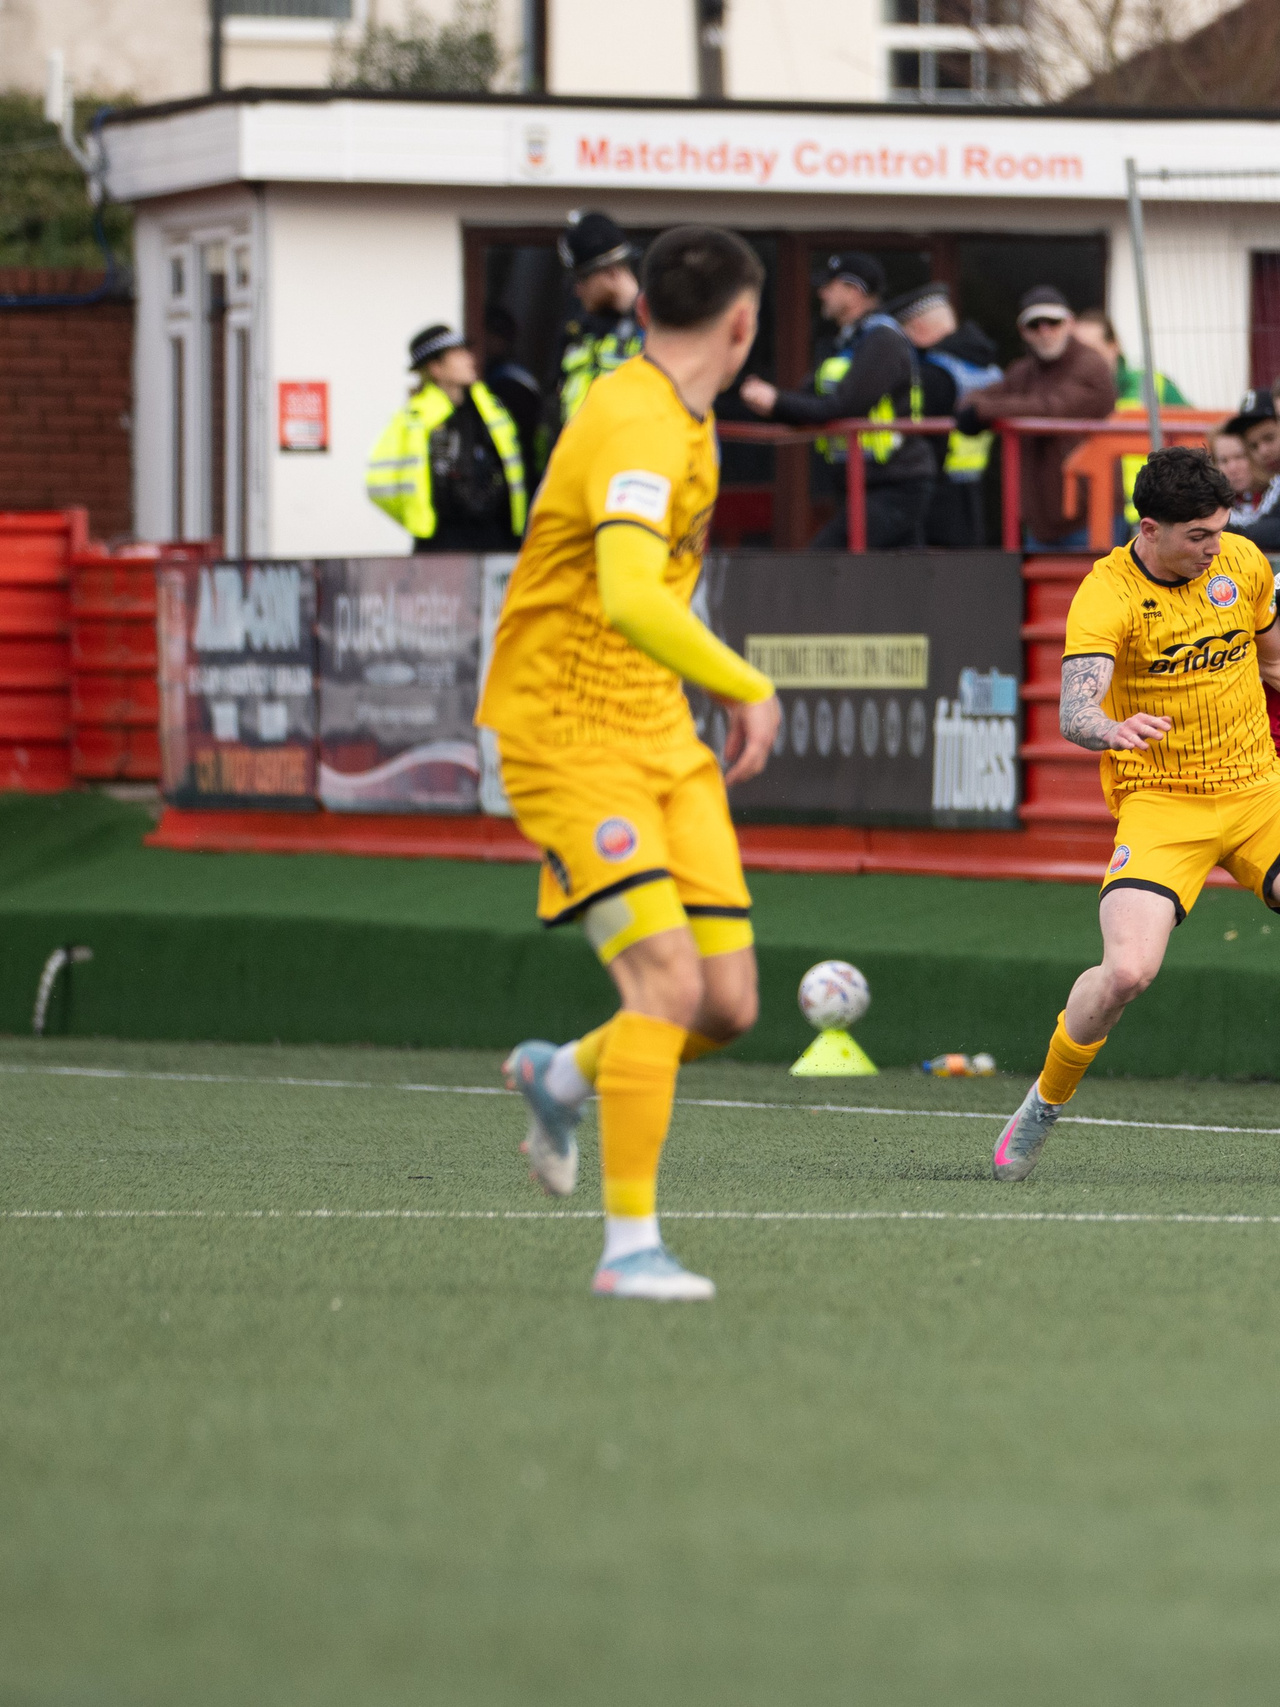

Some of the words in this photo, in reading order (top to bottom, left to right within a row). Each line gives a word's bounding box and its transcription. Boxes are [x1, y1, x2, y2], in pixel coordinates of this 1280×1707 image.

[577, 137, 779, 183] Matchday
[792, 141, 948, 179] Control
[962, 145, 1085, 181] Room
[1148, 640, 1250, 673] Bridges
